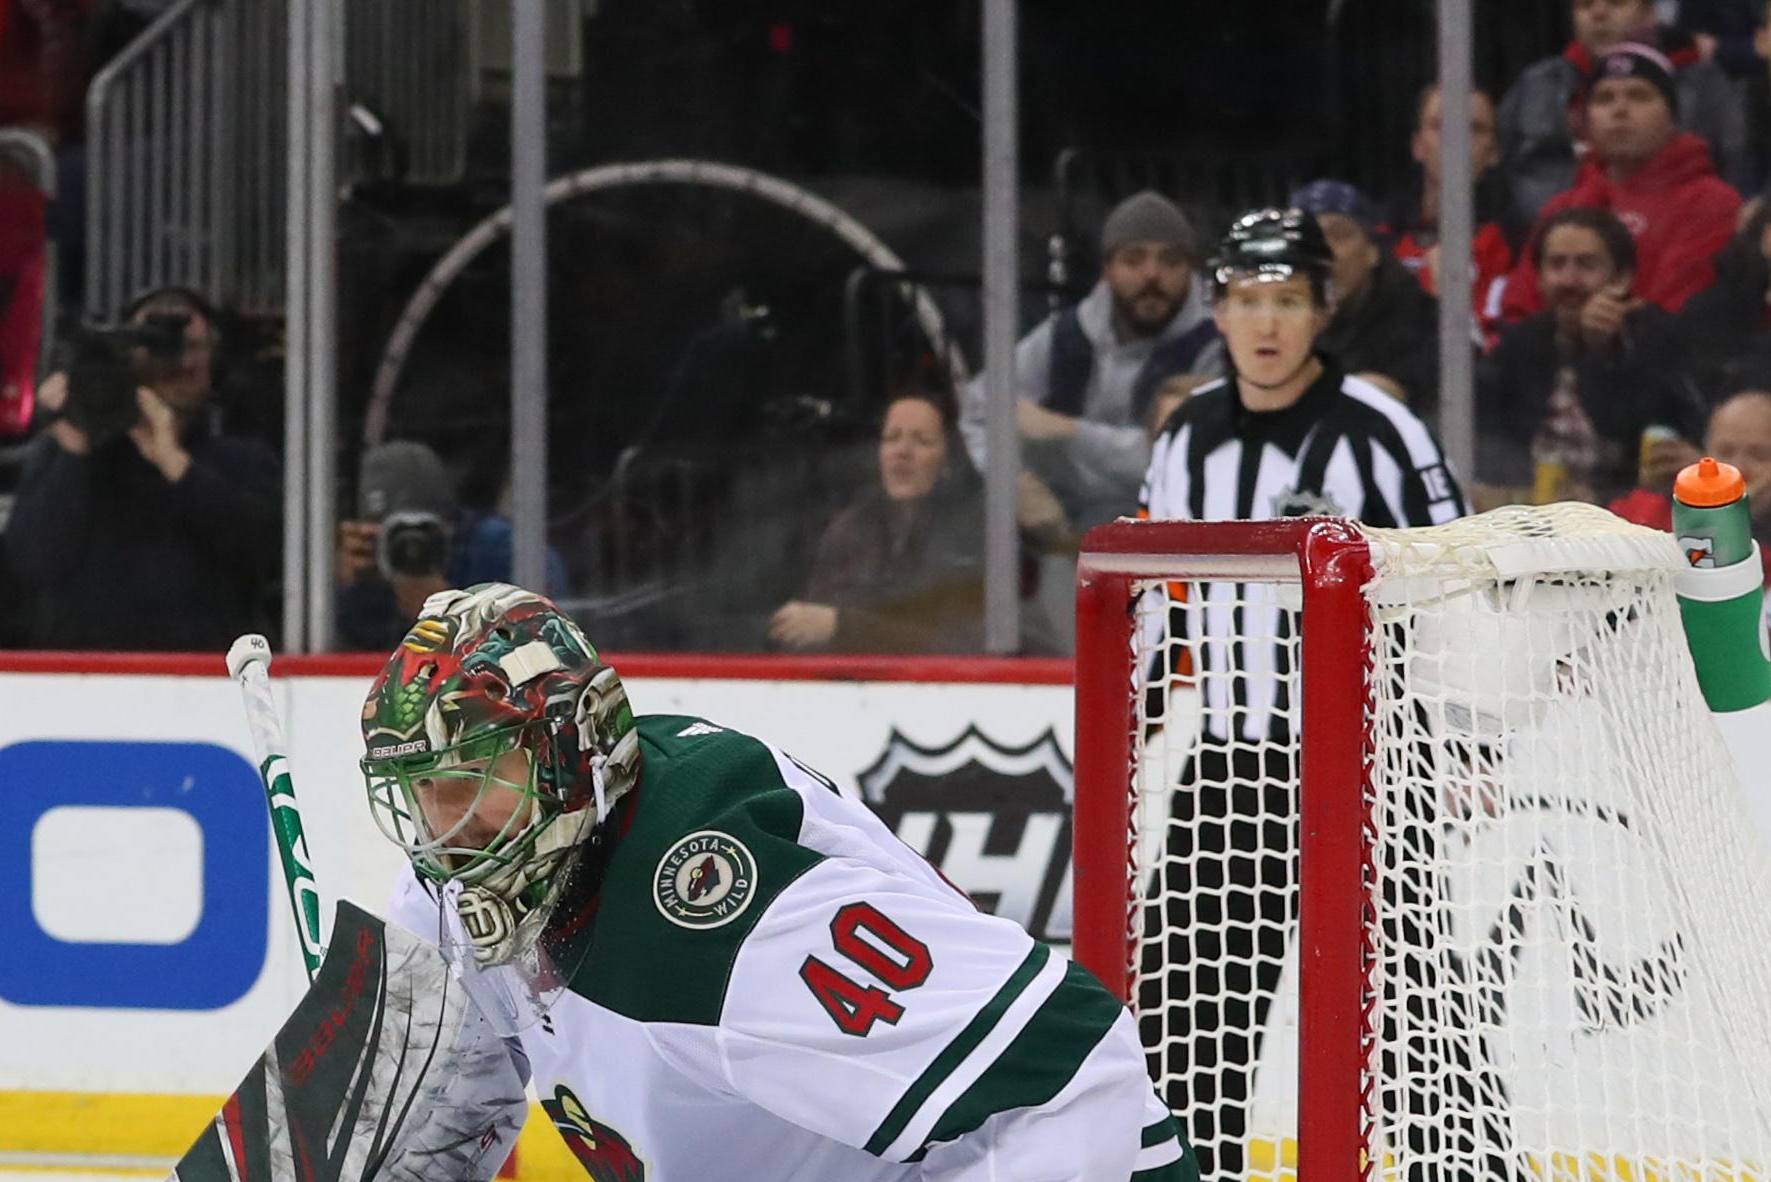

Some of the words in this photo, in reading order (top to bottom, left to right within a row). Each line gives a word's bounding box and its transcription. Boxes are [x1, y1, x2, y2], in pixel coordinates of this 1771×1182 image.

[250, 637, 265, 649] 40
[659, 838, 720, 908] MINNESOTA
[713, 878, 749, 917] WILD
[797, 900, 935, 1038] 40
